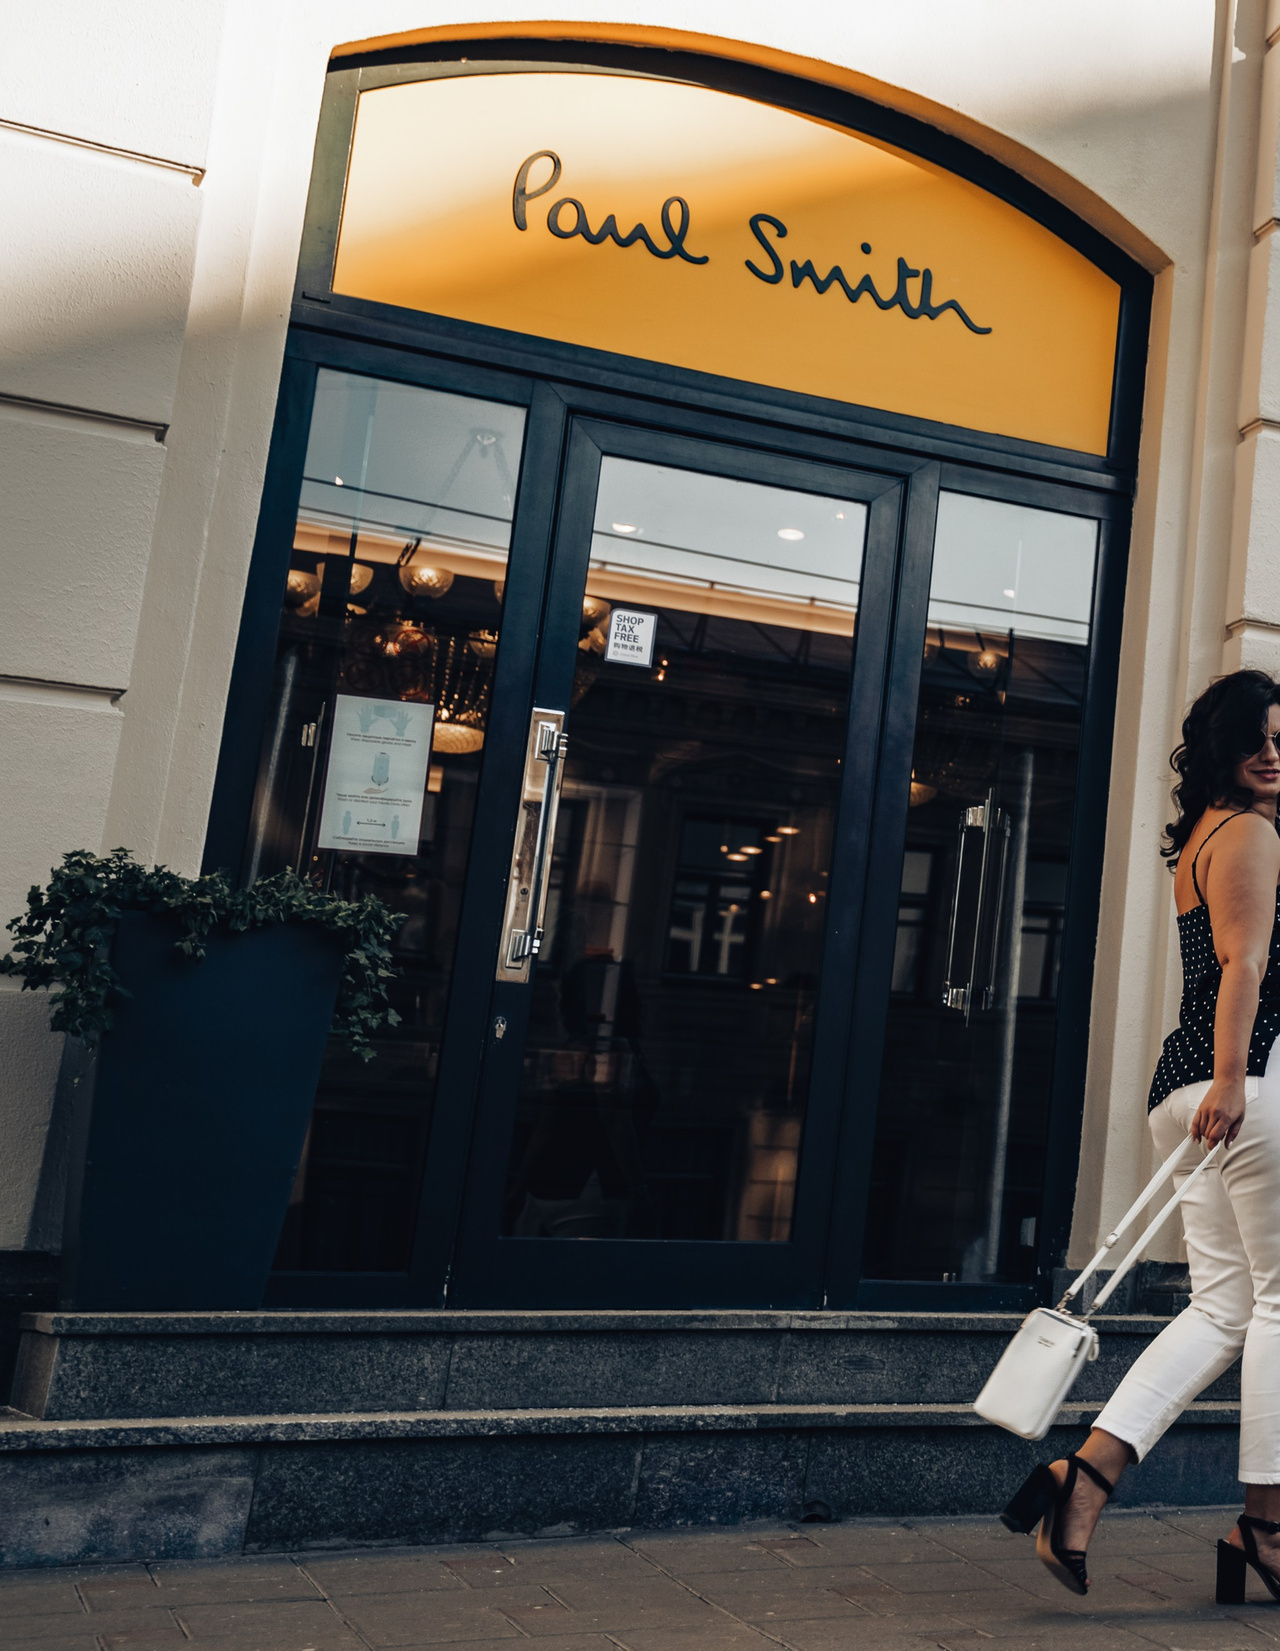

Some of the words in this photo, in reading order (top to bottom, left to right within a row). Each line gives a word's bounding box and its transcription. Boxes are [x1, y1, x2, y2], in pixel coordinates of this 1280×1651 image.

[512, 150, 709, 265] Paul
[745, 213, 992, 335] Smith
[616, 614, 644, 626] SHOP
[615, 623, 635, 634] TAX
[614, 632, 639, 644] FREE
